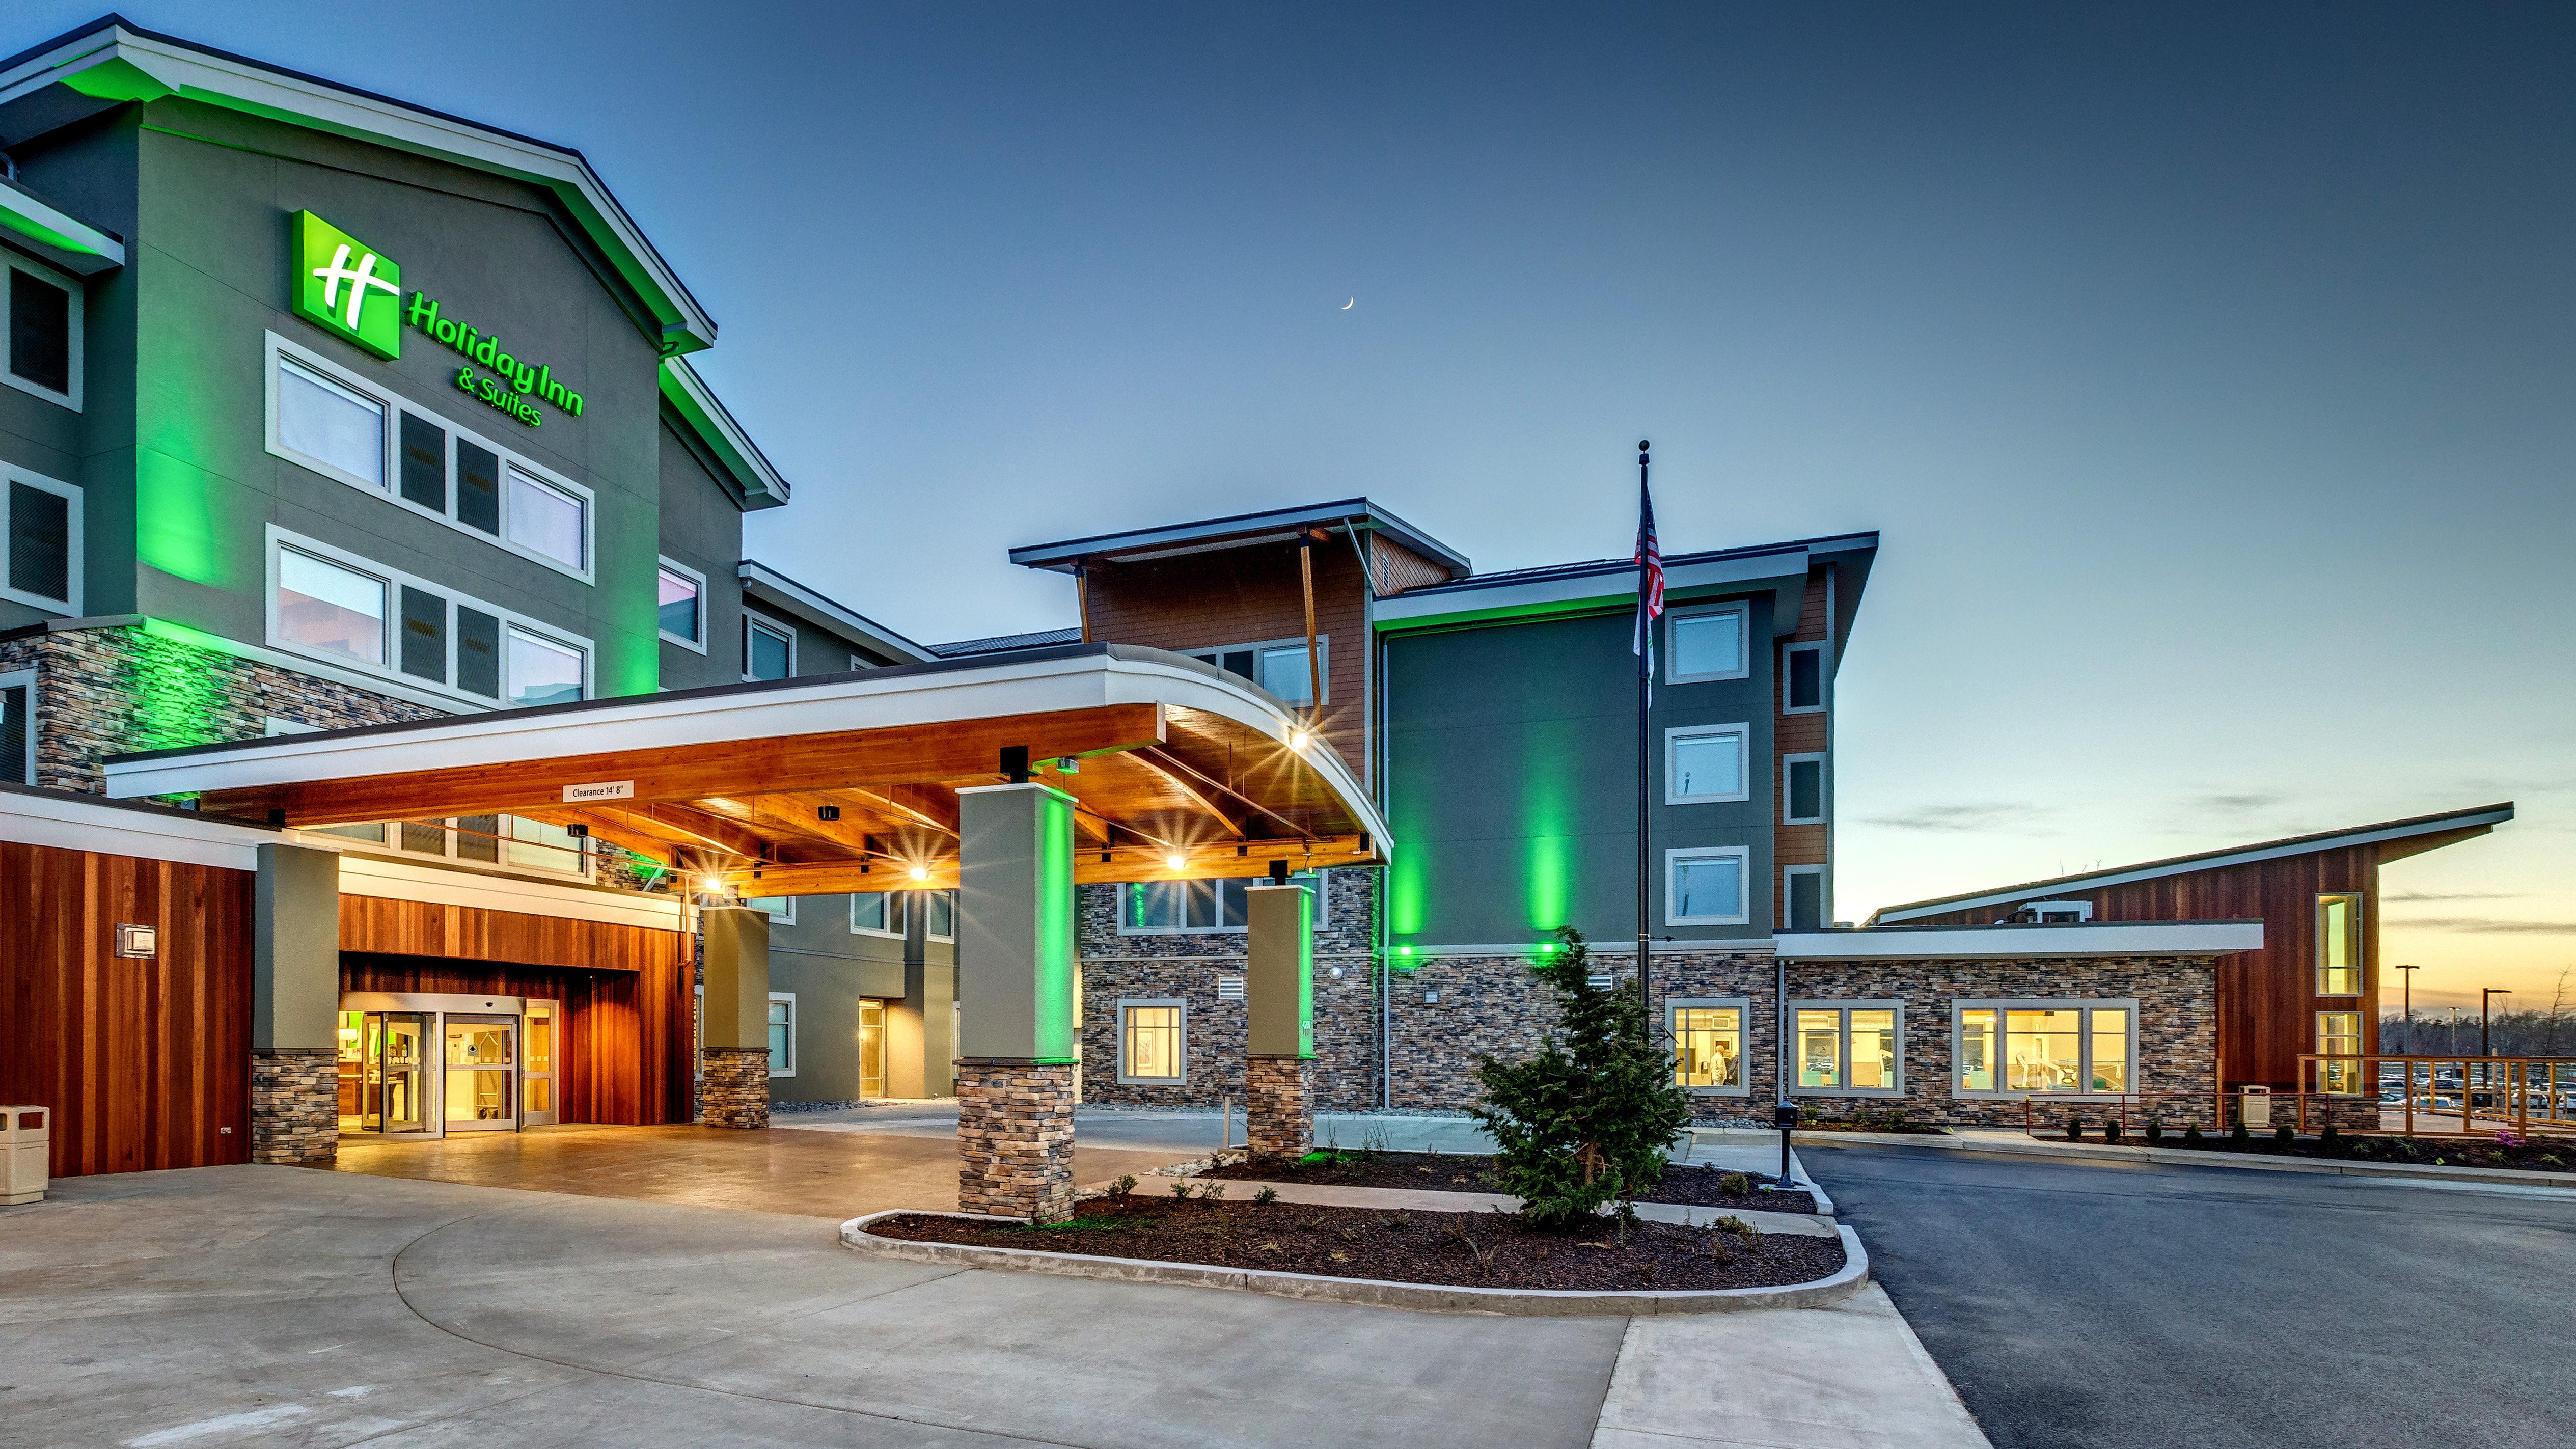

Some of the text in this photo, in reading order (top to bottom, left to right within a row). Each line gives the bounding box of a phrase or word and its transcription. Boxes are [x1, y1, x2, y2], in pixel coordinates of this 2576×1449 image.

[408, 291, 584, 417] Holiday Inn
[458, 366, 541, 427] & Suites
[573, 785, 623, 797] Clearance 14' 8"
